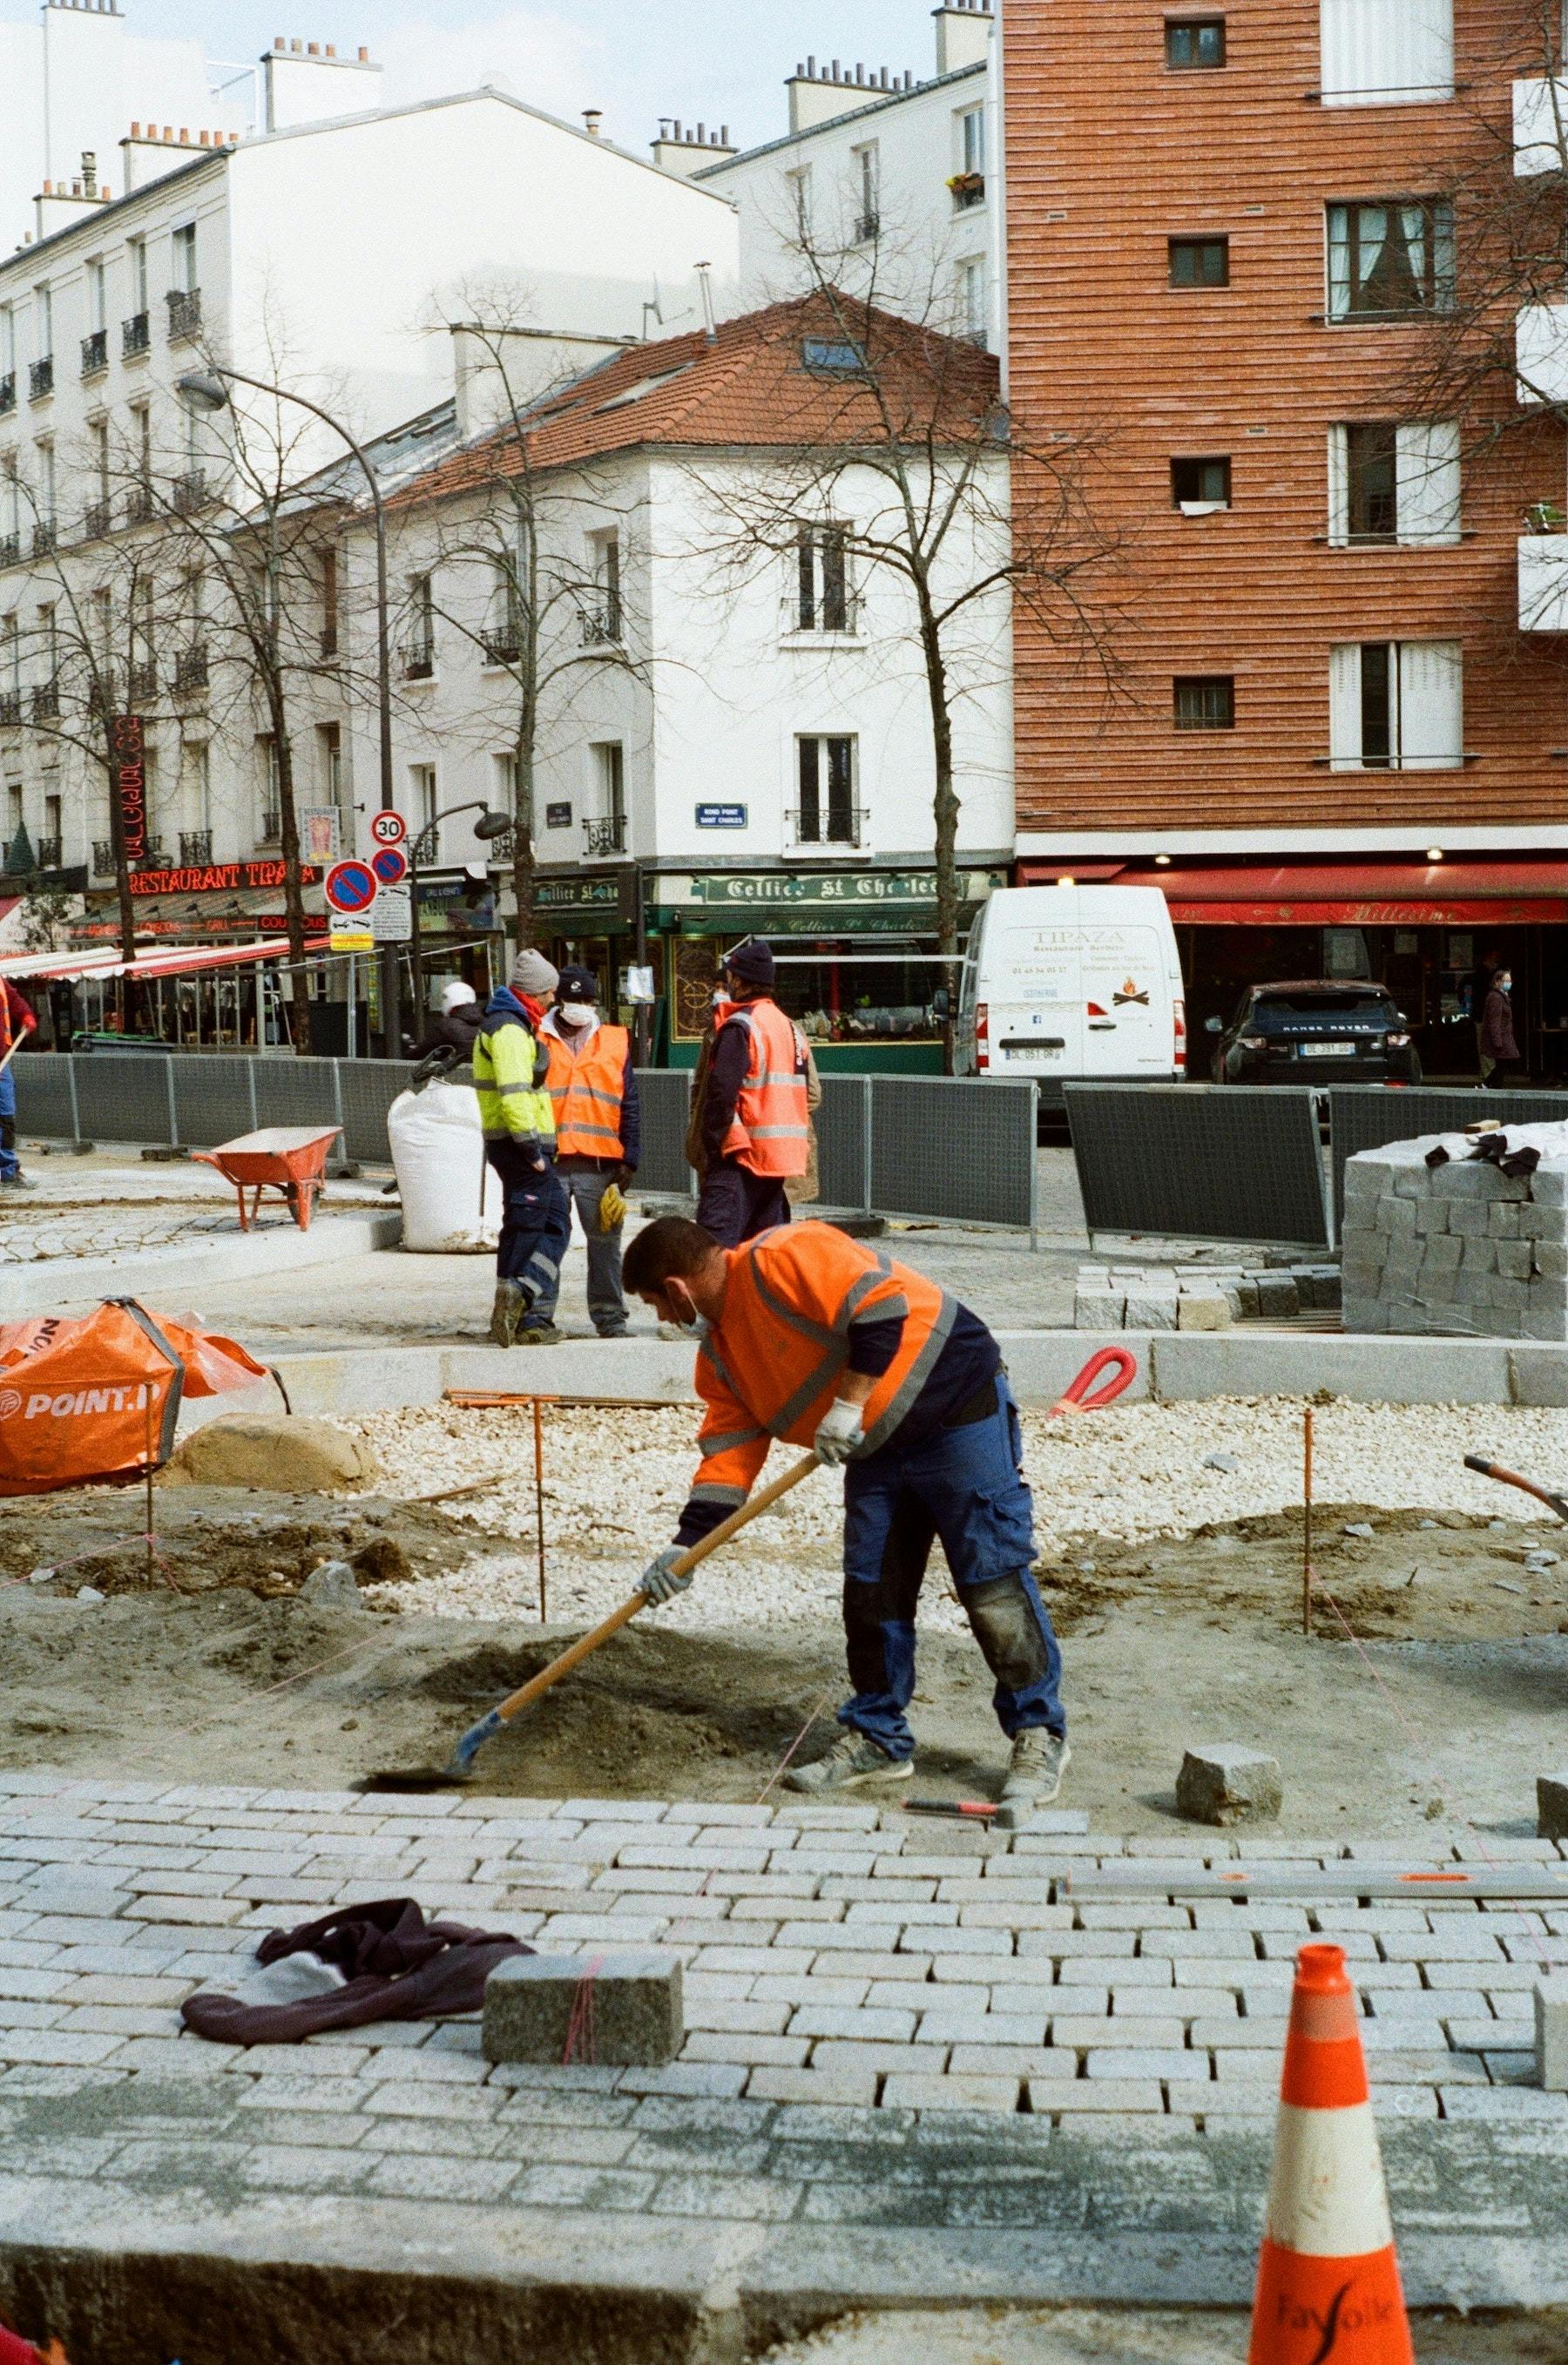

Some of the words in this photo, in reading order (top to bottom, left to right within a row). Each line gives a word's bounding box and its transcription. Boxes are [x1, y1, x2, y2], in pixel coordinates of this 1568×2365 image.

[378, 821, 399, 836] 30
[130, 864, 240, 894] RESTAURANT
[246, 861, 315, 886] TIPAA
[821, 879, 844, 898] St
[856, 878, 937, 898] Chales
[260, 916, 327, 930] COUOUS
[1031, 931, 1126, 943] TIPAZA
